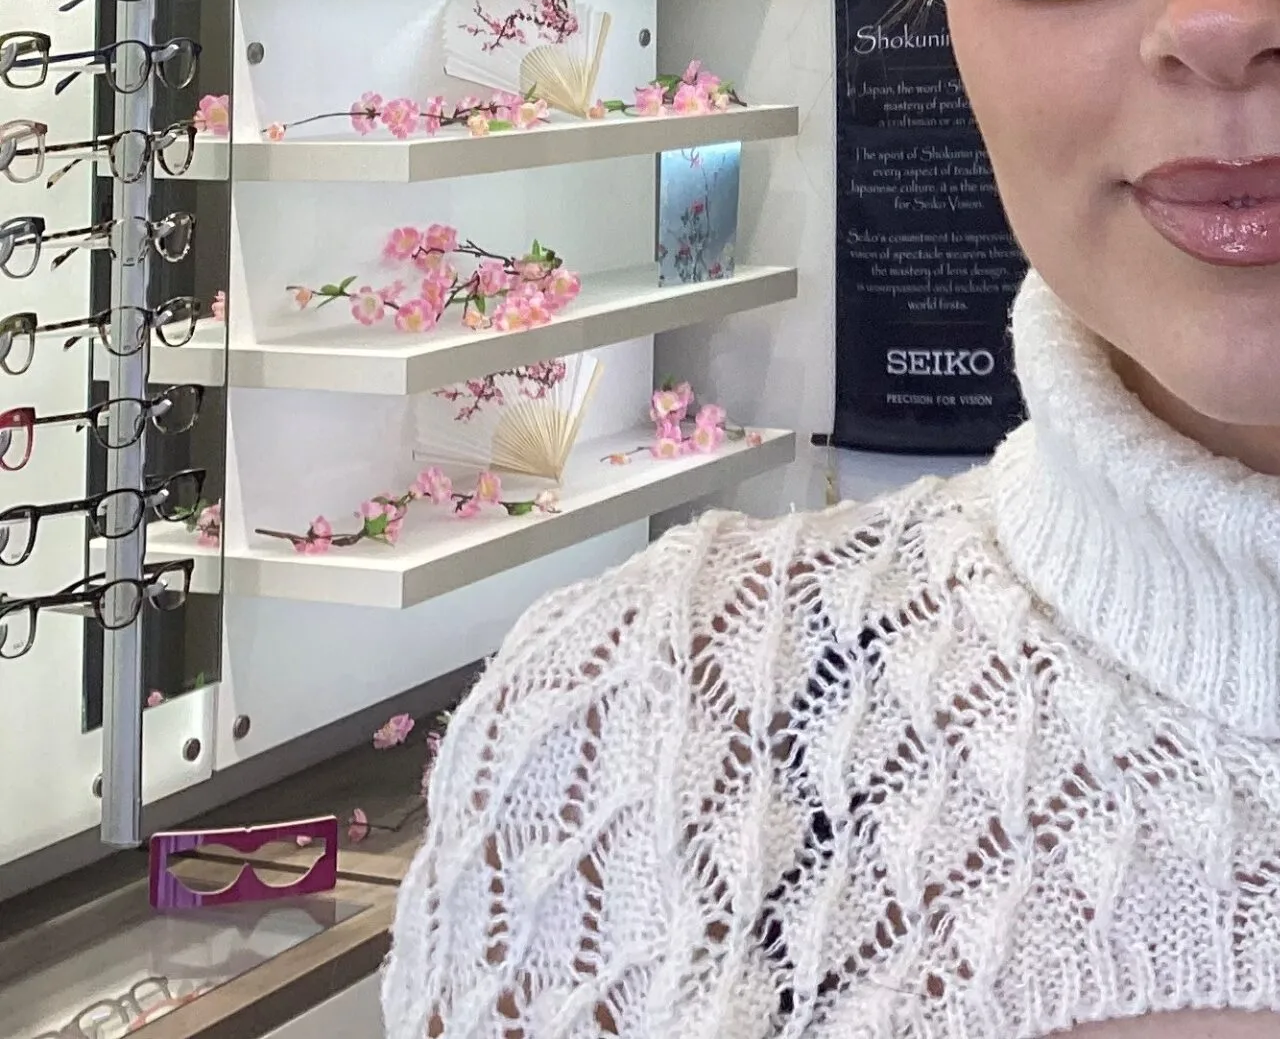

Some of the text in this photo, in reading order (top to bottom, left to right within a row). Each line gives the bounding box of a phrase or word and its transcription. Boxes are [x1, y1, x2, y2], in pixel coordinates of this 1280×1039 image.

[898, 81, 915, 95] the
[916, 80, 941, 95] word
[883, 100, 924, 113] mastery
[926, 97, 937, 110] of
[856, 146, 876, 163] The
[878, 148, 904, 165] spirit
[906, 146, 918, 160] of
[873, 167, 901, 179] every
[903, 166, 938, 181] aspect
[940, 163, 951, 176] of
[850, 179, 897, 198] Japanese
[960, 179, 978, 192] the
[894, 196, 911, 209] for
[888, 231, 948, 243] commitment
[951, 231, 963, 243] to
[879, 247, 890, 259] of
[893, 246, 943, 264] spectacle
[871, 263, 887, 277] the
[889, 265, 931, 280] mastery
[933, 263, 944, 276] of
[946, 263, 968, 276] lens
[932, 279, 952, 293] and
[907, 297, 937, 310] world
[887, 350, 995, 375] SEIKO
[887, 394, 993, 406] PRECISION FOR VISION
